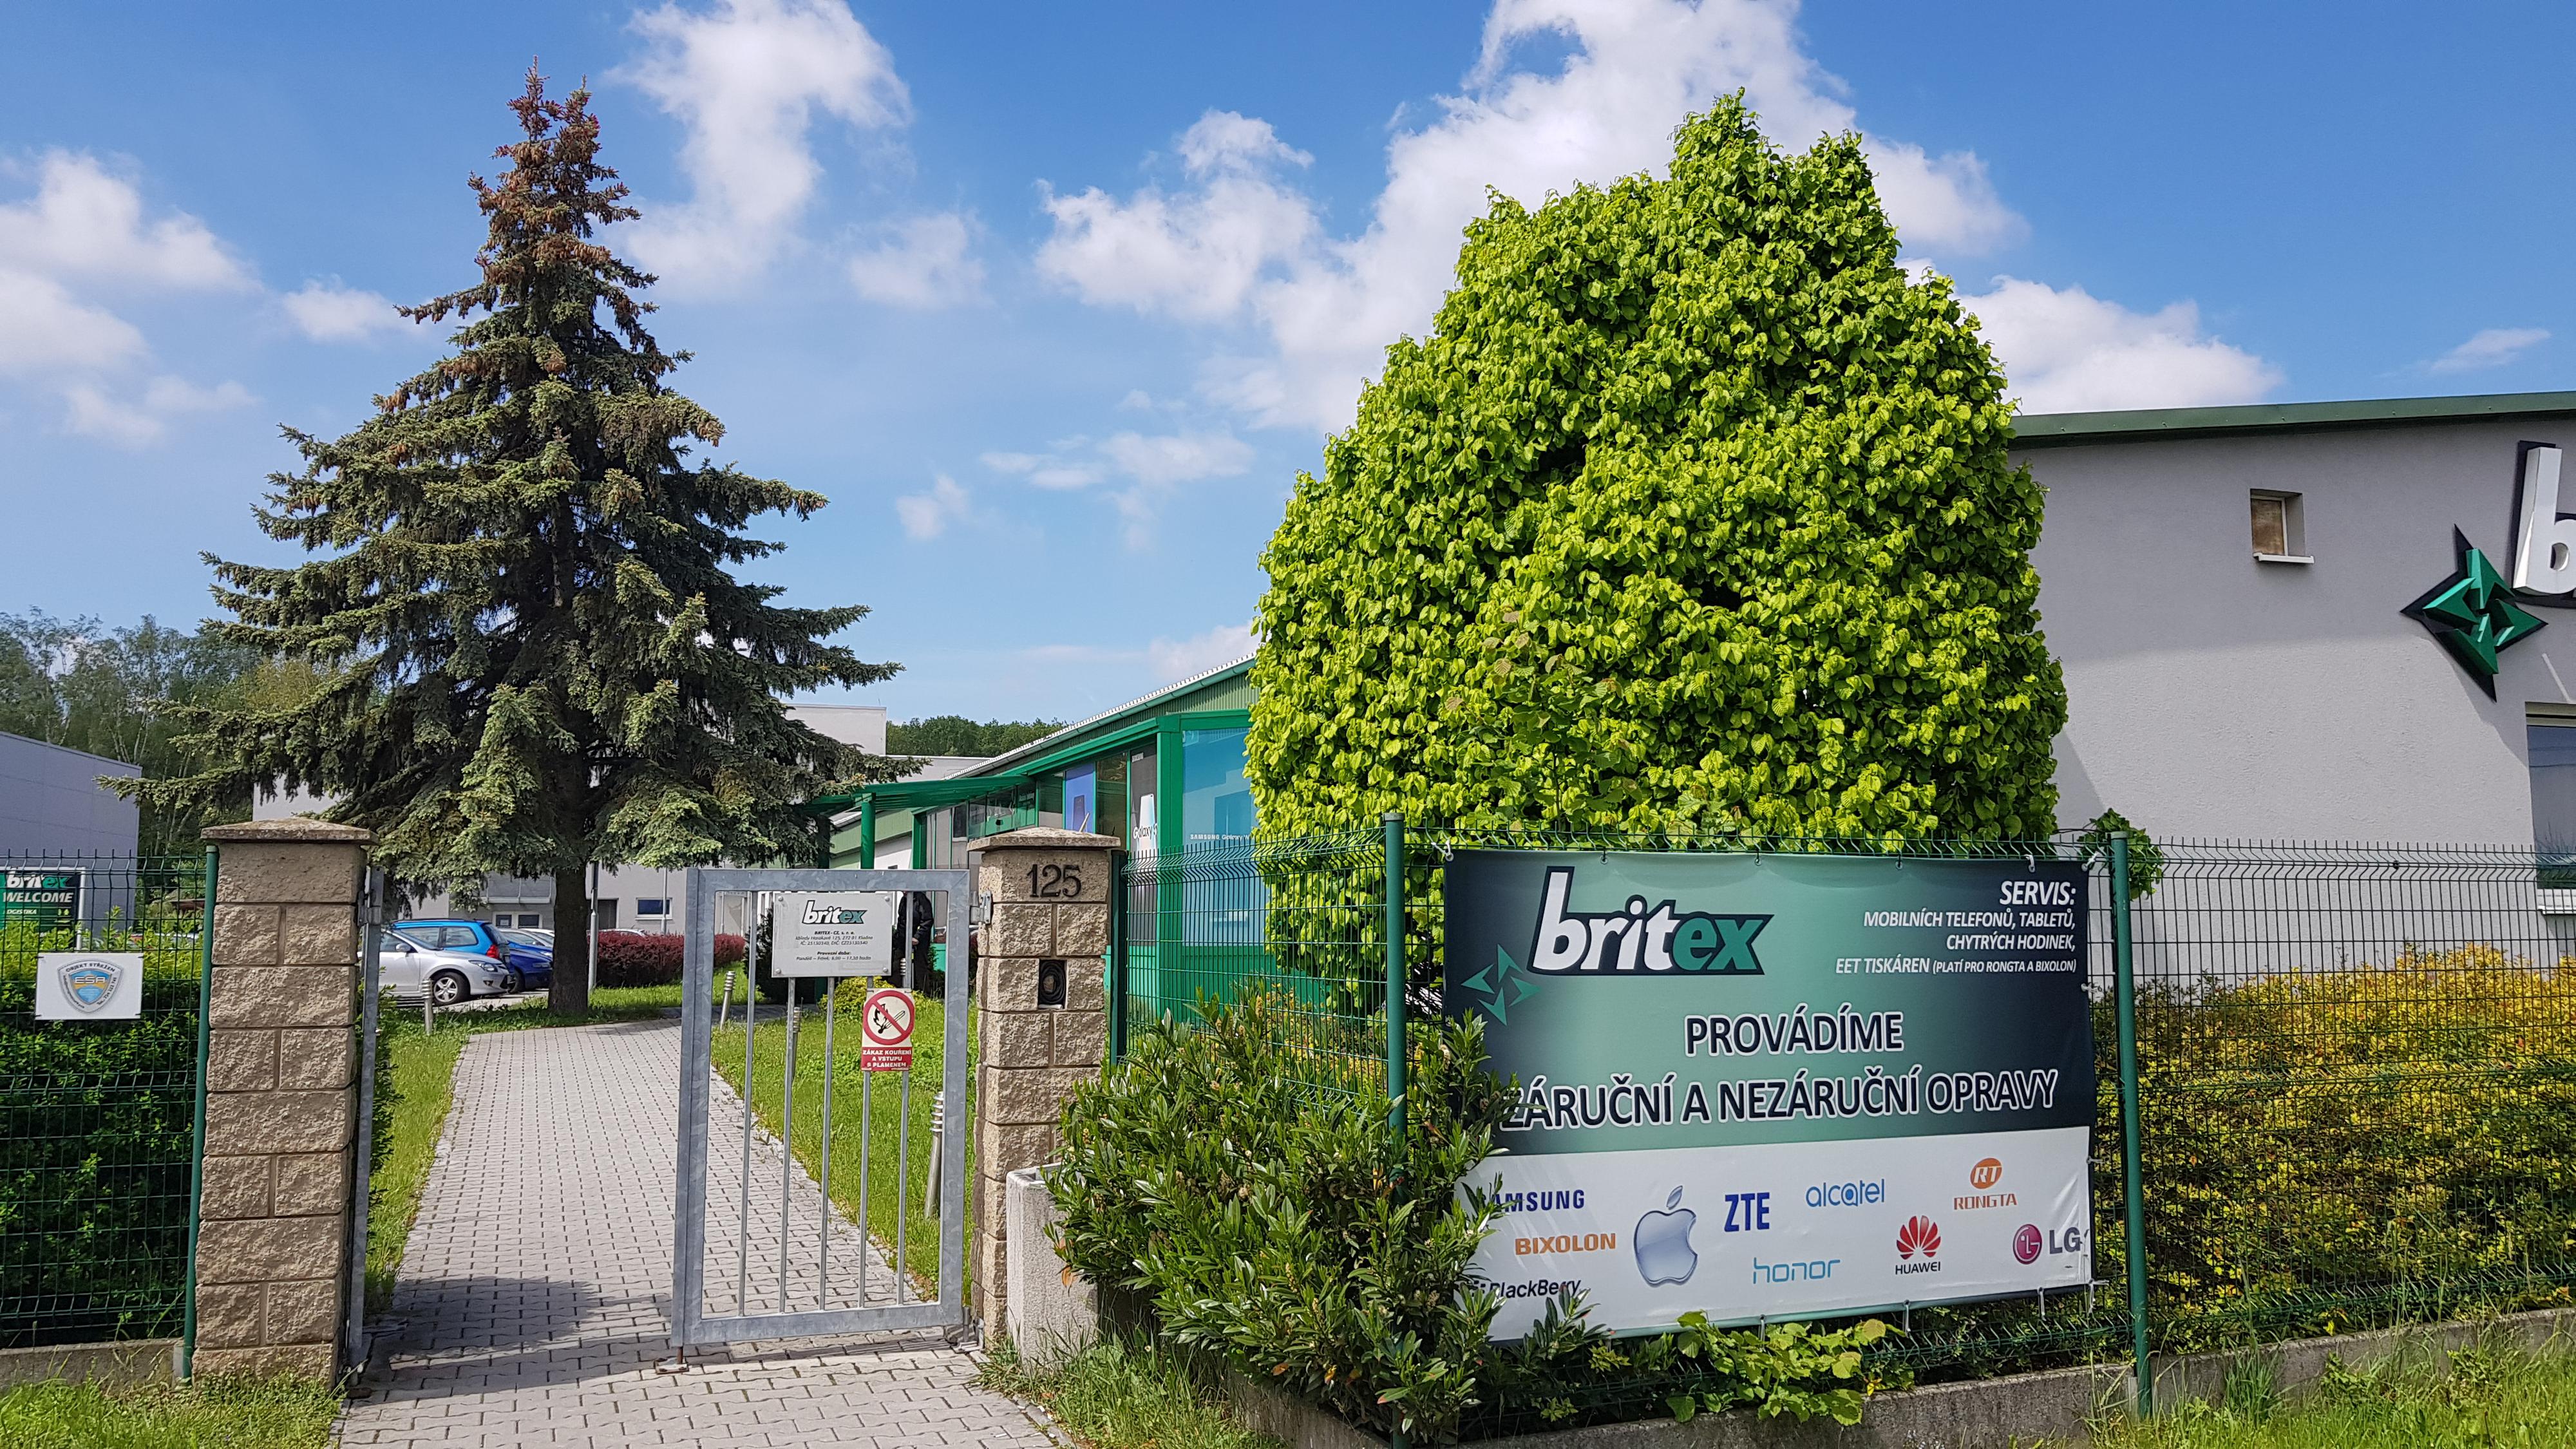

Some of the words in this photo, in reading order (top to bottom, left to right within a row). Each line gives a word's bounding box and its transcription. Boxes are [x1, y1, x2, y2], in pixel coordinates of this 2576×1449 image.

[1133, 826, 1152, 840] Galaxy
[6, 867, 71, 888] britex
[1027, 864, 1081, 897] 125
[3, 892, 73, 902] WELCOME
[1999, 880, 2076, 905] SERVIS:
[802, 900, 867, 924] britex
[1528, 867, 1771, 974] britex
[1864, 907, 1942, 927] MOBILNÍCH
[1946, 907, 2016, 929] TELEFONŮ,
[2020, 908, 2076, 930] TABLETŮ,
[1946, 931, 2014, 950] CHYTRÝCH
[2017, 934, 2076, 952] HODINEK,
[1836, 958, 1861, 974] EET
[1864, 953, 1930, 973] TISKÁREN
[1932, 958, 1964, 974] (PLATÍ
[1964, 961, 1984, 972] PRO
[1985, 961, 2025, 972] RONGTA
[2026, 961, 2034, 972] A
[2035, 960, 2076, 973] BIXOLON)
[1685, 1002, 1904, 1057] PROVÁDÍME
[1499, 1072, 1676, 1131] ZÁRUČNÍ
[1680, 1081, 1711, 1124] A
[1718, 1064, 1922, 1123] NEZÁRUČNÍ
[1926, 1069, 2058, 1113] OPRAVY
[1973, 1166, 2002, 1183] RT
[1481, 1189, 1585, 1213] AMSUNG
[1806, 1179, 1884, 1208] alcatel
[1954, 1193, 2018, 1210] RONGTA
[1724, 1192, 1770, 1233] ZTE
[1515, 1233, 1616, 1255] BIXOLON
[2049, 1227, 2081, 1255] LG
[1753, 1257, 1841, 1284] honor
[1895, 1262, 1941, 1274] HUAWEI
[1490, 1279, 1582, 1298] BlackBery
